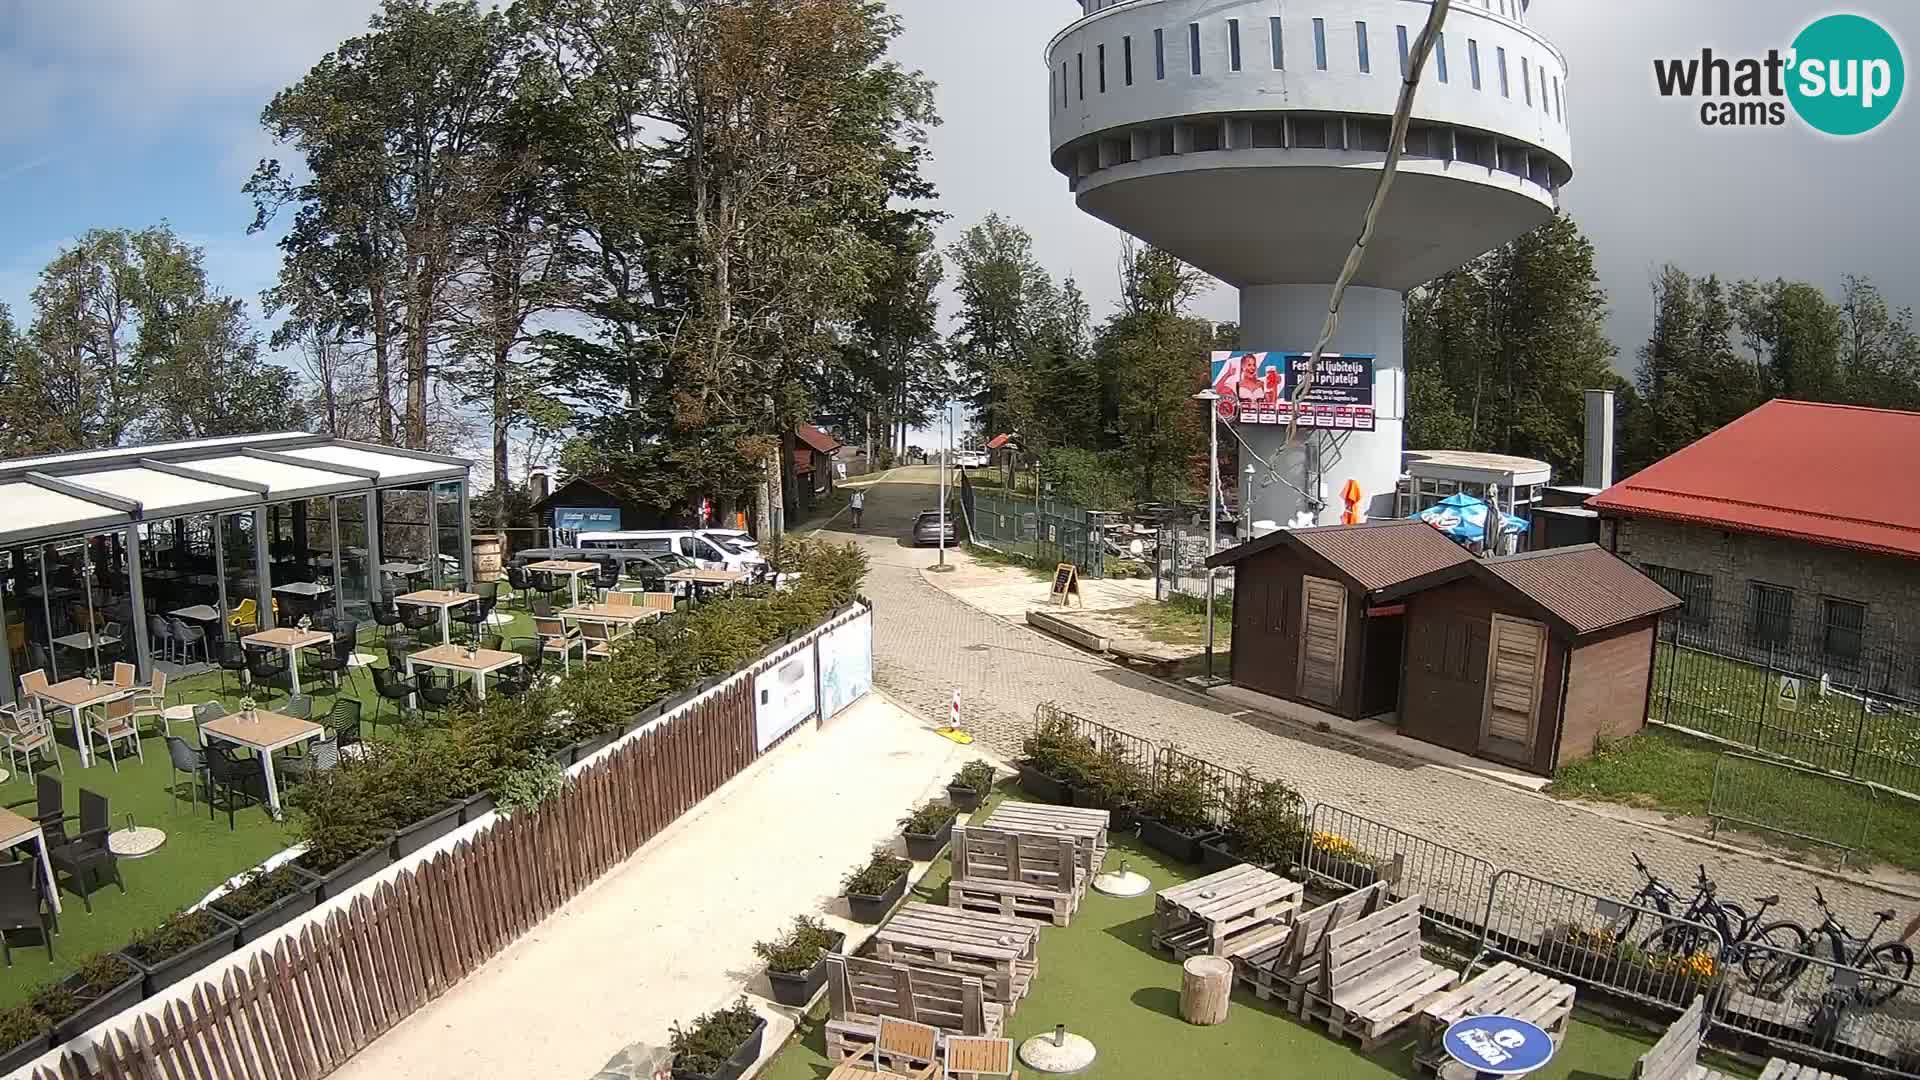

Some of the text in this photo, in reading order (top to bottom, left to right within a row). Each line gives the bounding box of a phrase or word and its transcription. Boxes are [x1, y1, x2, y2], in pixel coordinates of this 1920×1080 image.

[1292, 360, 1363, 375] Festal ljubitelja
[1297, 372, 1315, 384] pia
[1320, 373, 1359, 386] prijatelja
